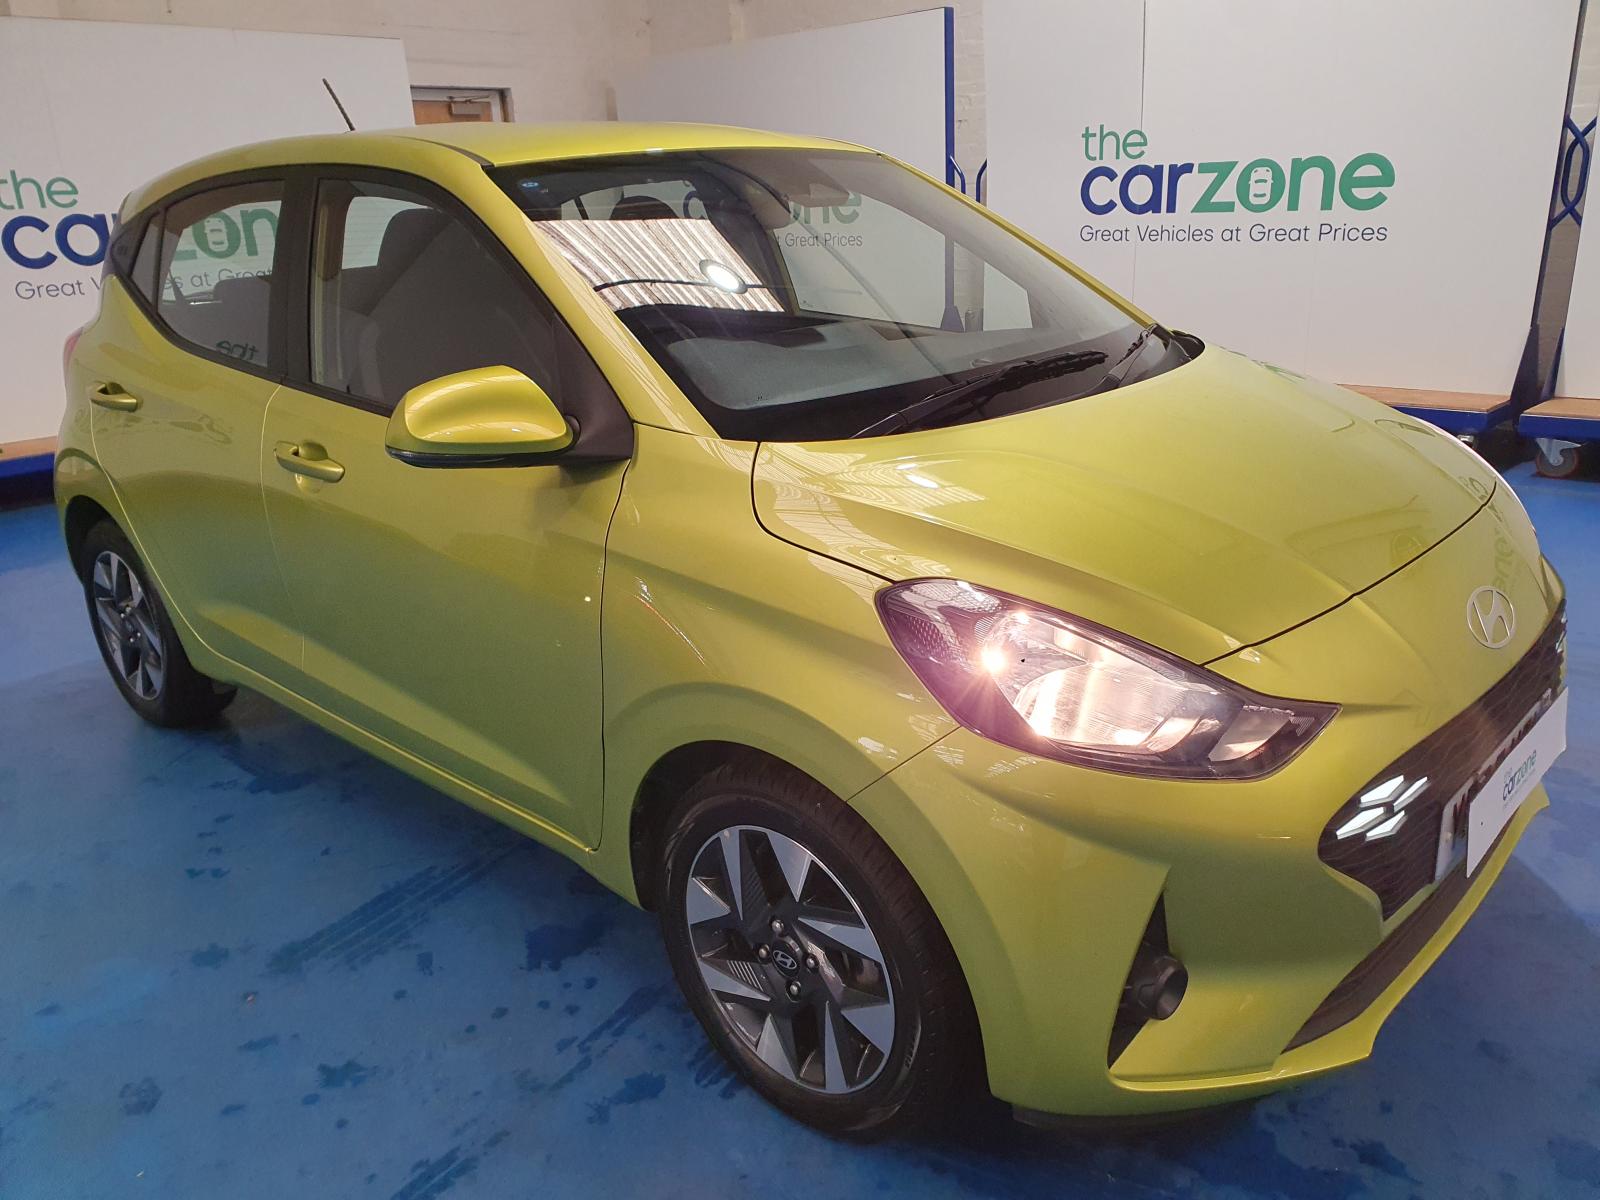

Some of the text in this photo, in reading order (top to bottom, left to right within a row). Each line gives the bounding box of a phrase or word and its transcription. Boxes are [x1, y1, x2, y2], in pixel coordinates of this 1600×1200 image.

[1081, 124, 1148, 161] the
[0, 169, 79, 210] the
[1080, 152, 1395, 215] carzone
[785, 233, 818, 247] Great
[824, 232, 863, 247] Prices
[1080, 223, 1388, 242] Great Vehicles at Great Prices
[15, 280, 85, 300] Great
[190, 271, 212, 288] at
